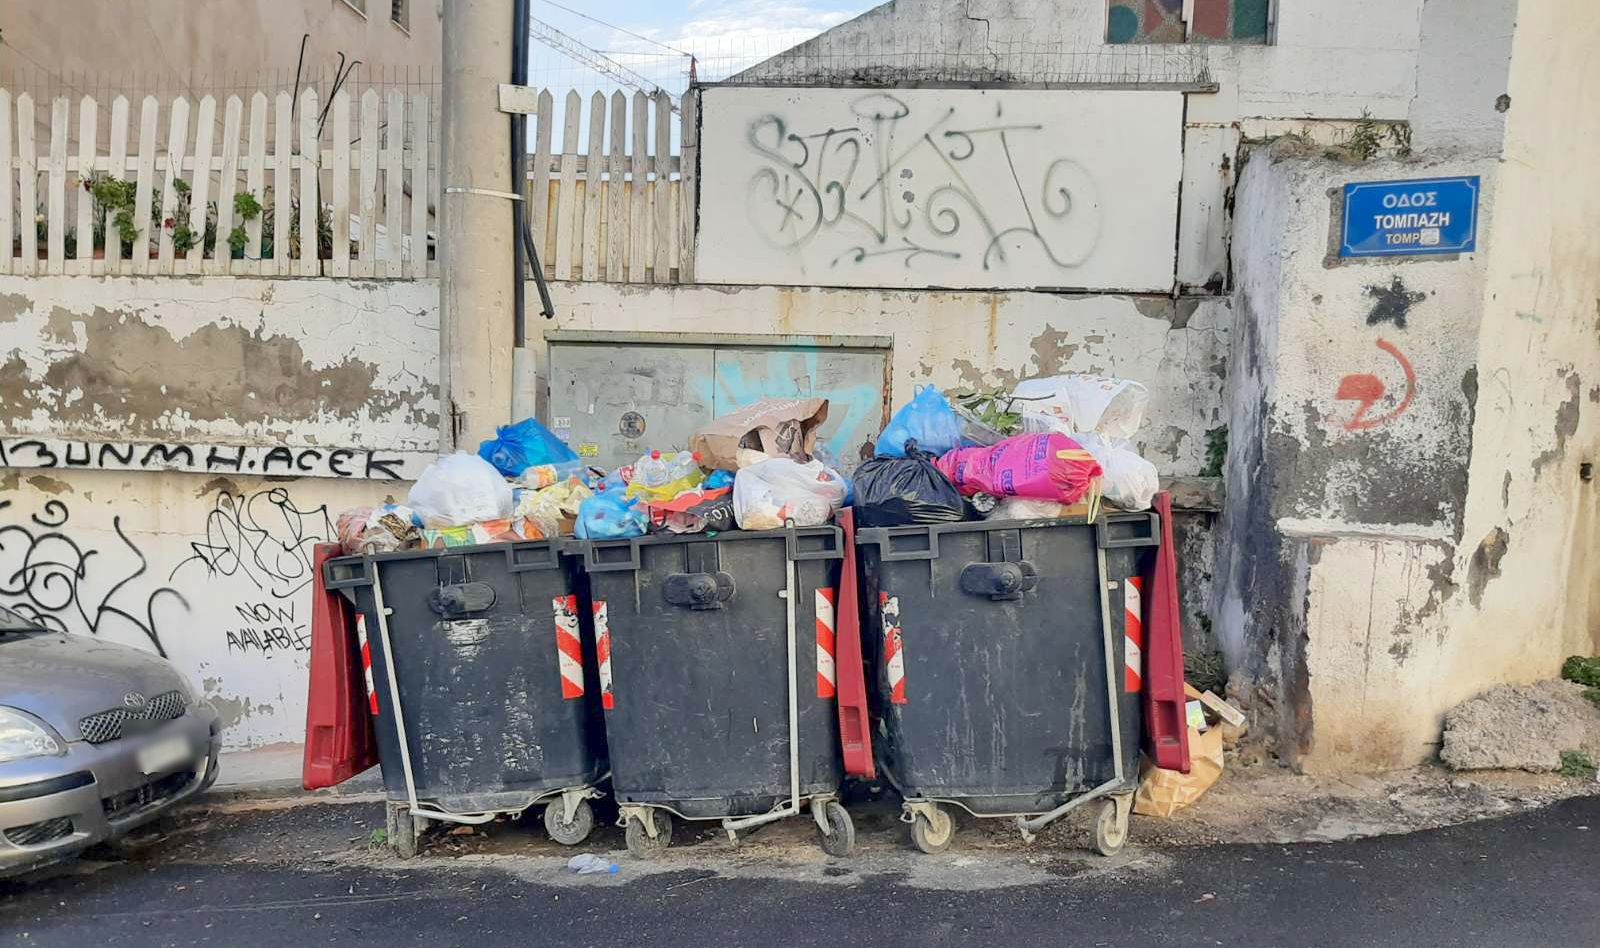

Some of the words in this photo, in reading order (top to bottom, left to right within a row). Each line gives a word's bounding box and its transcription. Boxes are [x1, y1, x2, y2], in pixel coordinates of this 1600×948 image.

[1382, 191, 1437, 208] ΟΔΟΣ
[1374, 212, 1450, 229] ΤΟΜΠΑΖΗ
[1385, 230, 1437, 245] TOMP
[235, 600, 294, 624] NOW
[226, 625, 312, 656] AVAILABLE
